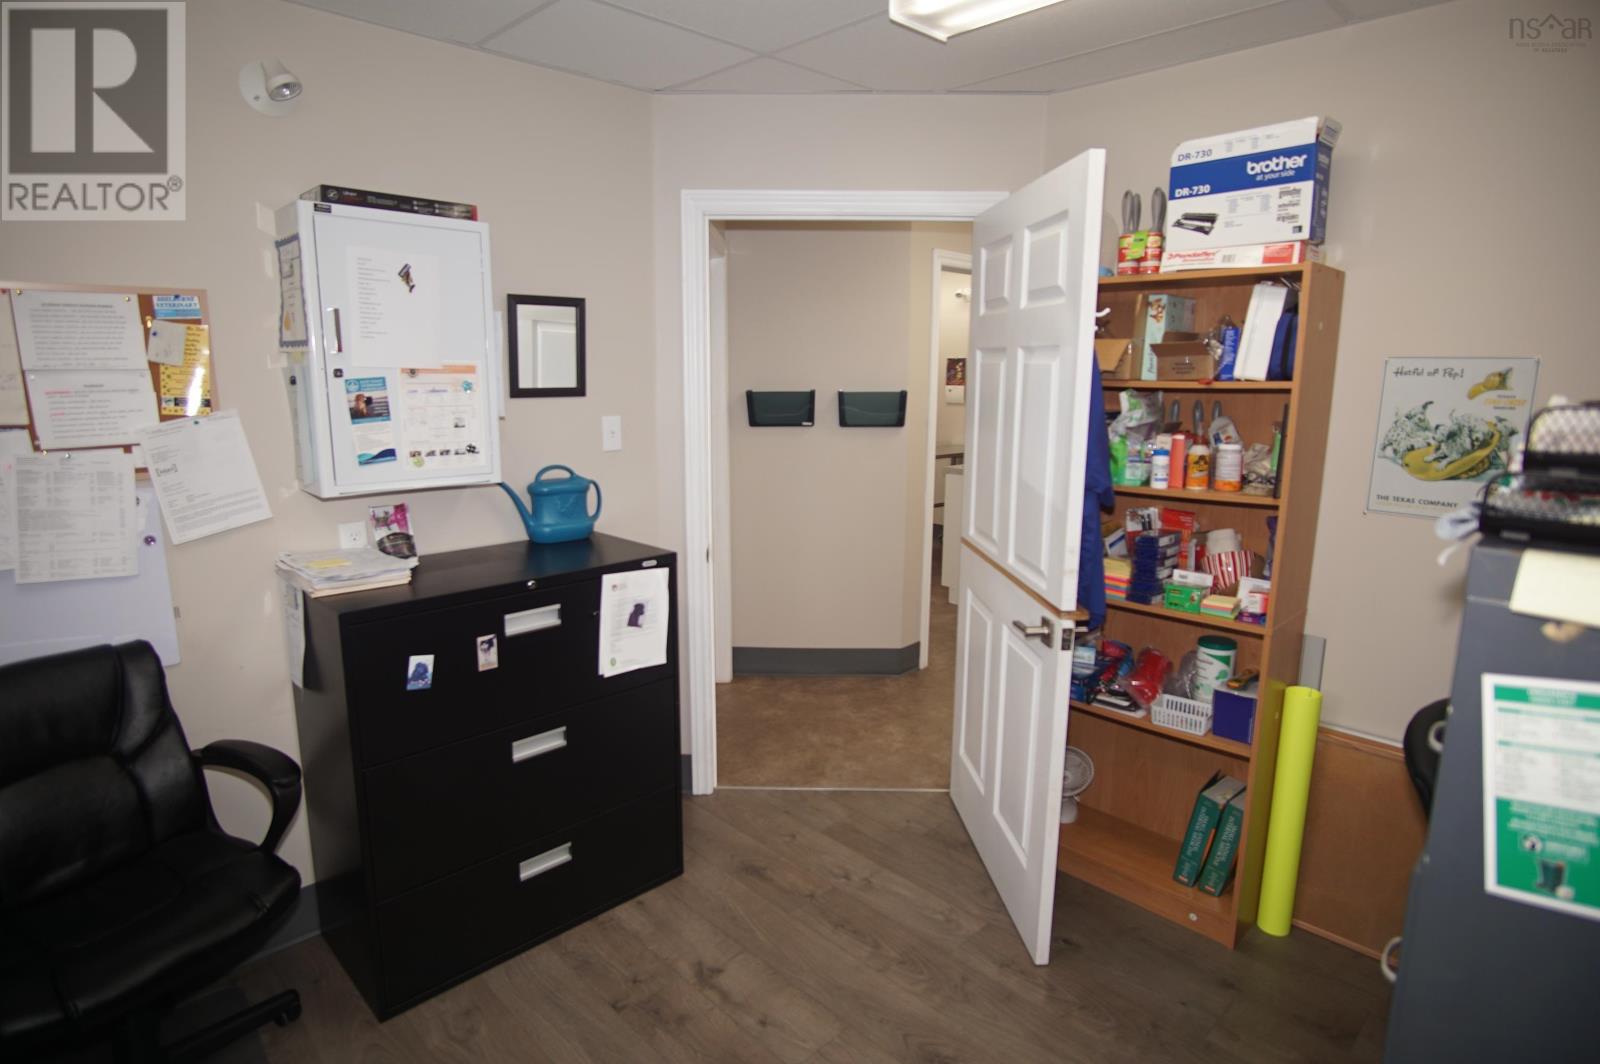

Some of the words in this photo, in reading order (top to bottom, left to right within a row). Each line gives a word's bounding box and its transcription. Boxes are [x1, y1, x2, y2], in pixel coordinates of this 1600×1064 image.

[1178, 149, 1212, 162] DR-730
[1247, 154, 1307, 175] brother
[1265, 171, 1281, 182] your
[1281, 168, 1296, 179] side
[1175, 184, 1210, 197] DR-730
[1427, 367, 1439, 378] of
[1392, 495, 1416, 504] TEXAS
[1418, 498, 1458, 509] COMPANY
